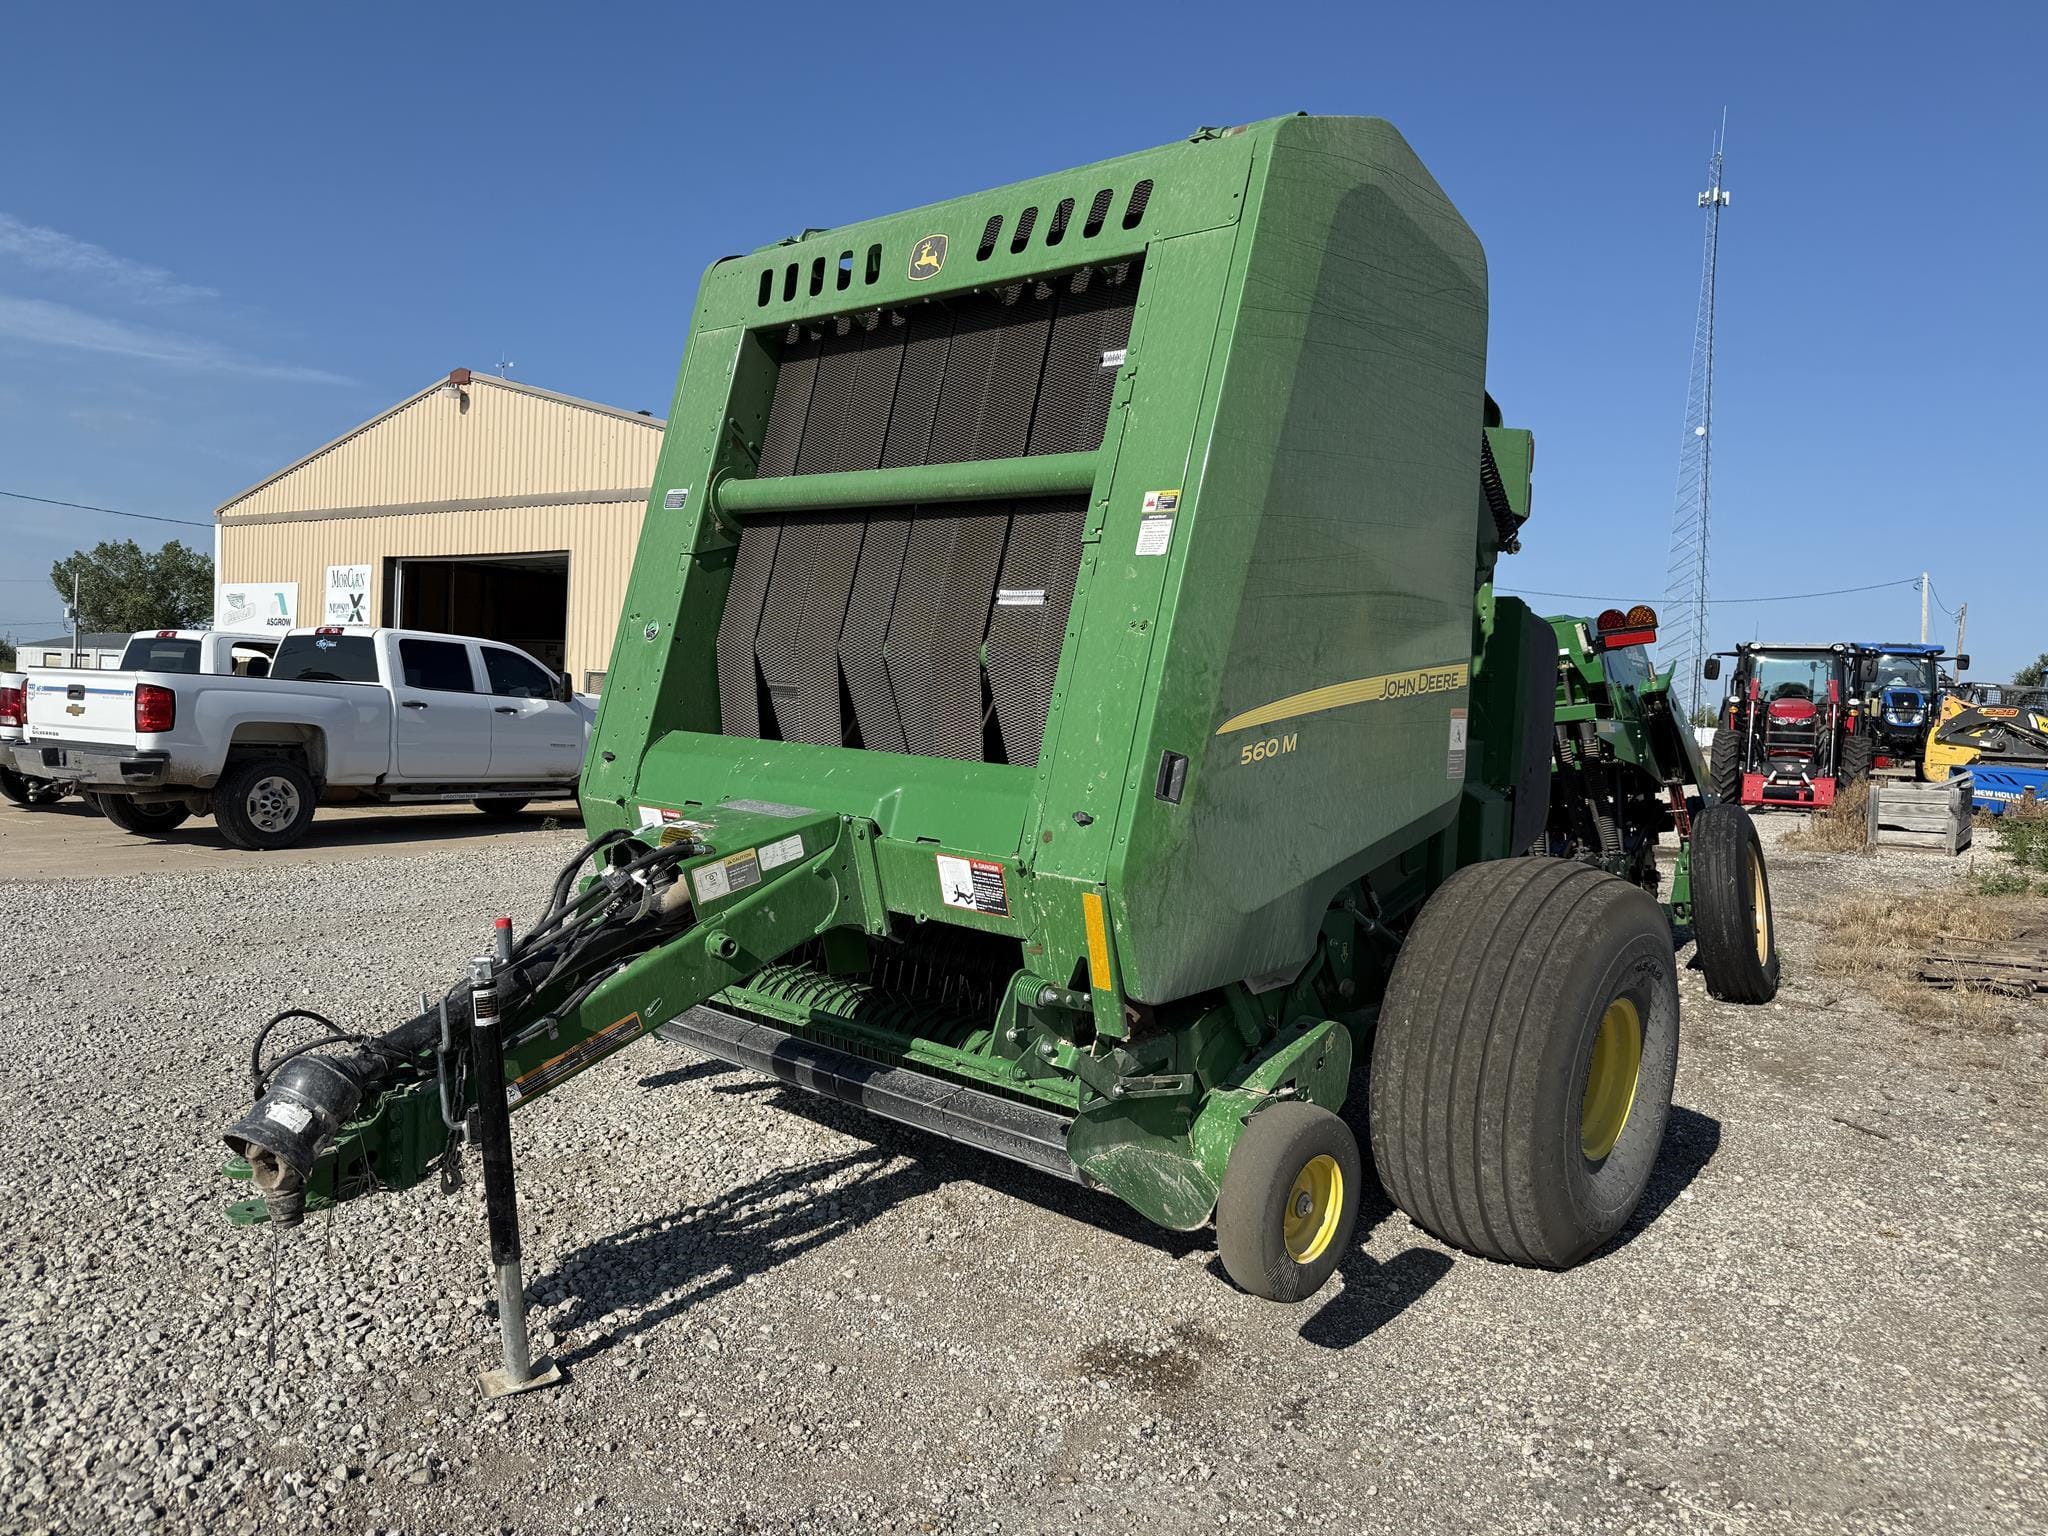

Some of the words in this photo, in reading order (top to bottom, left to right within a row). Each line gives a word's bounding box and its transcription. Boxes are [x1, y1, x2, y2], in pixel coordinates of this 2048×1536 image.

[266, 617, 292, 627] ASGROW
[1379, 678, 1416, 700] JOHN
[1418, 672, 1459, 693] DEERE
[1240, 738, 1279, 765] 560
[1281, 732, 1298, 754] M
[1974, 788, 1993, 798] NEW
[732, 852, 752, 863] CAUTION
[978, 863, 1000, 872] DANGER
